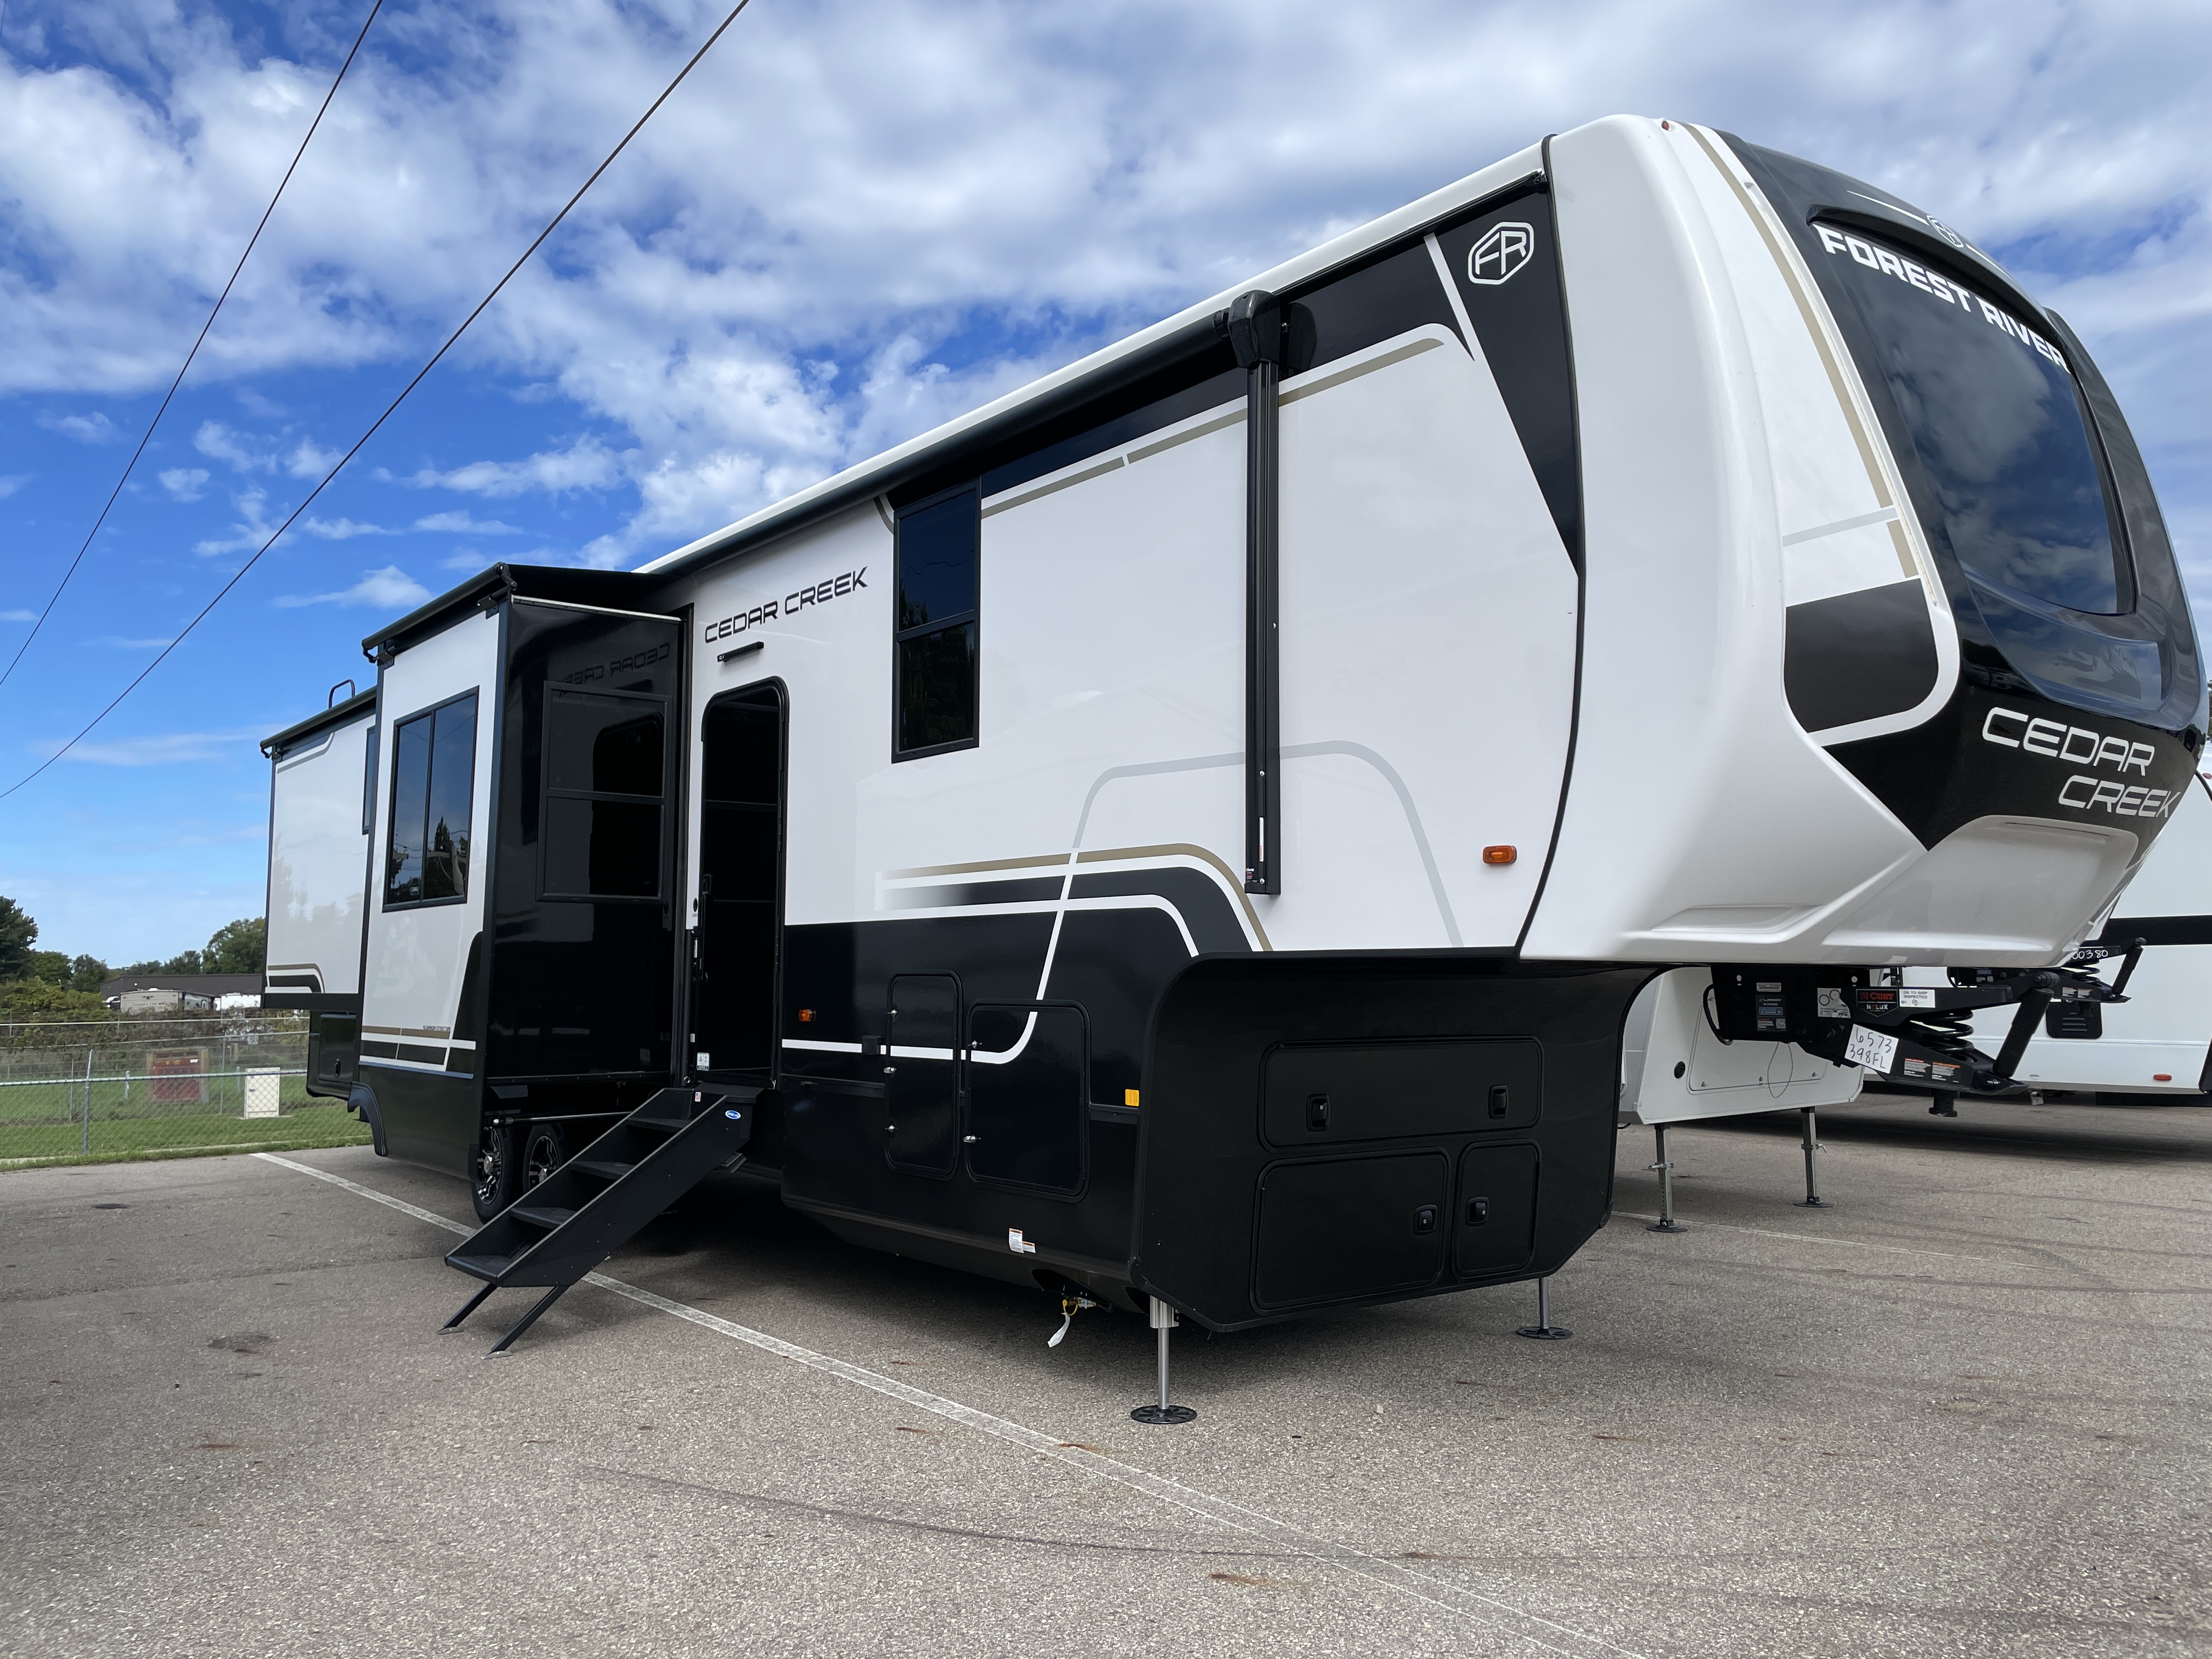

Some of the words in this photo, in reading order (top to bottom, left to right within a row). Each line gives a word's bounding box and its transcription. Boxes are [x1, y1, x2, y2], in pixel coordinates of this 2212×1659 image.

[1812, 223, 1972, 313] FOREST
[1974, 296, 2071, 375] RIVER
[704, 600, 778, 644] CEDAR
[785, 566, 868, 615] CREEK
[1982, 707, 2156, 777] CEDAR
[2058, 774, 2181, 818] CREEK
[1850, 1043, 1887, 1069] 398FL
[1855, 1027, 1892, 1054] 6573
